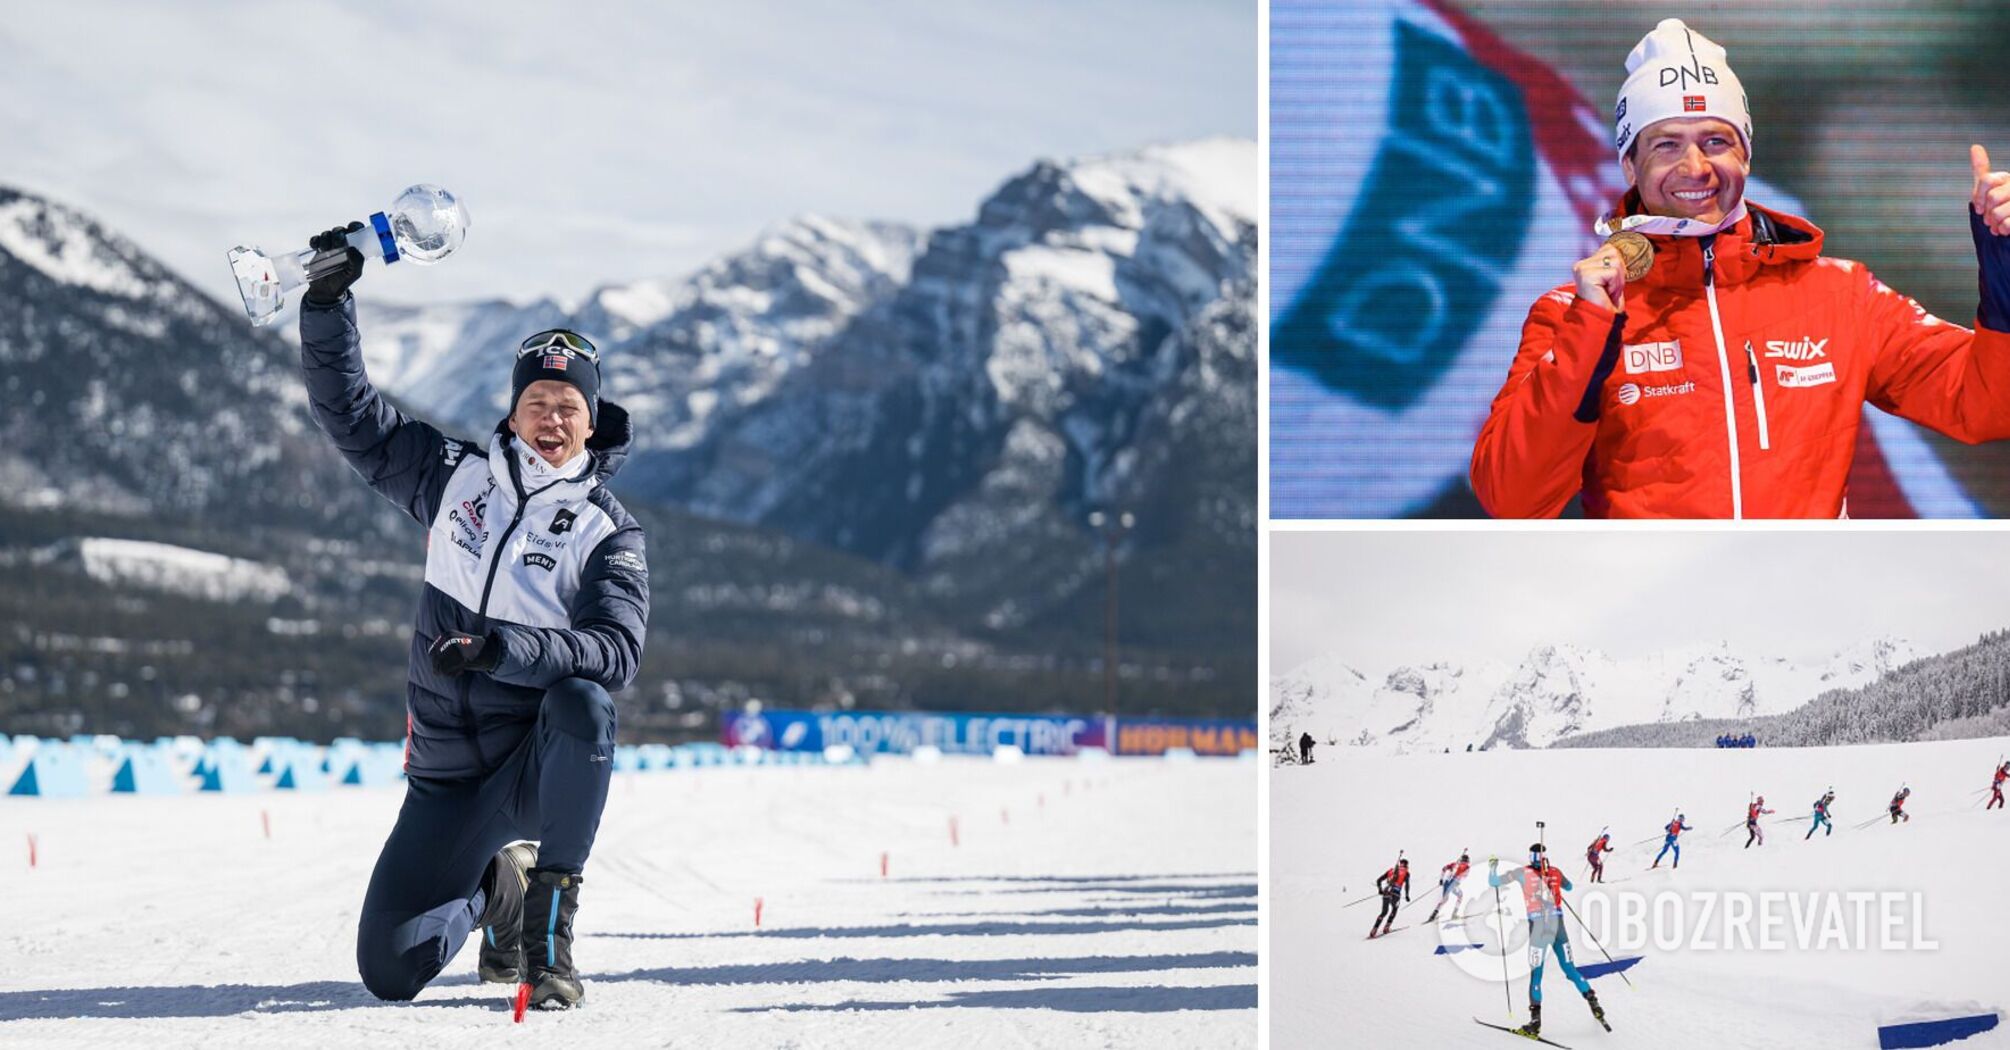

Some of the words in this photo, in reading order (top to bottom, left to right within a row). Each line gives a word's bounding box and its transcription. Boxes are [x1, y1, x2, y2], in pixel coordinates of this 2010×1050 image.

[1660, 54, 1719, 90] DNB
[1329, 66, 1516, 364] DNB
[1631, 342, 1677, 371] DNB
[1644, 382, 1695, 398] Statkraft
[526, 555, 556, 569] MENY
[819, 714, 919, 752] 100%
[922, 716, 1087, 756] ELECTRIC
